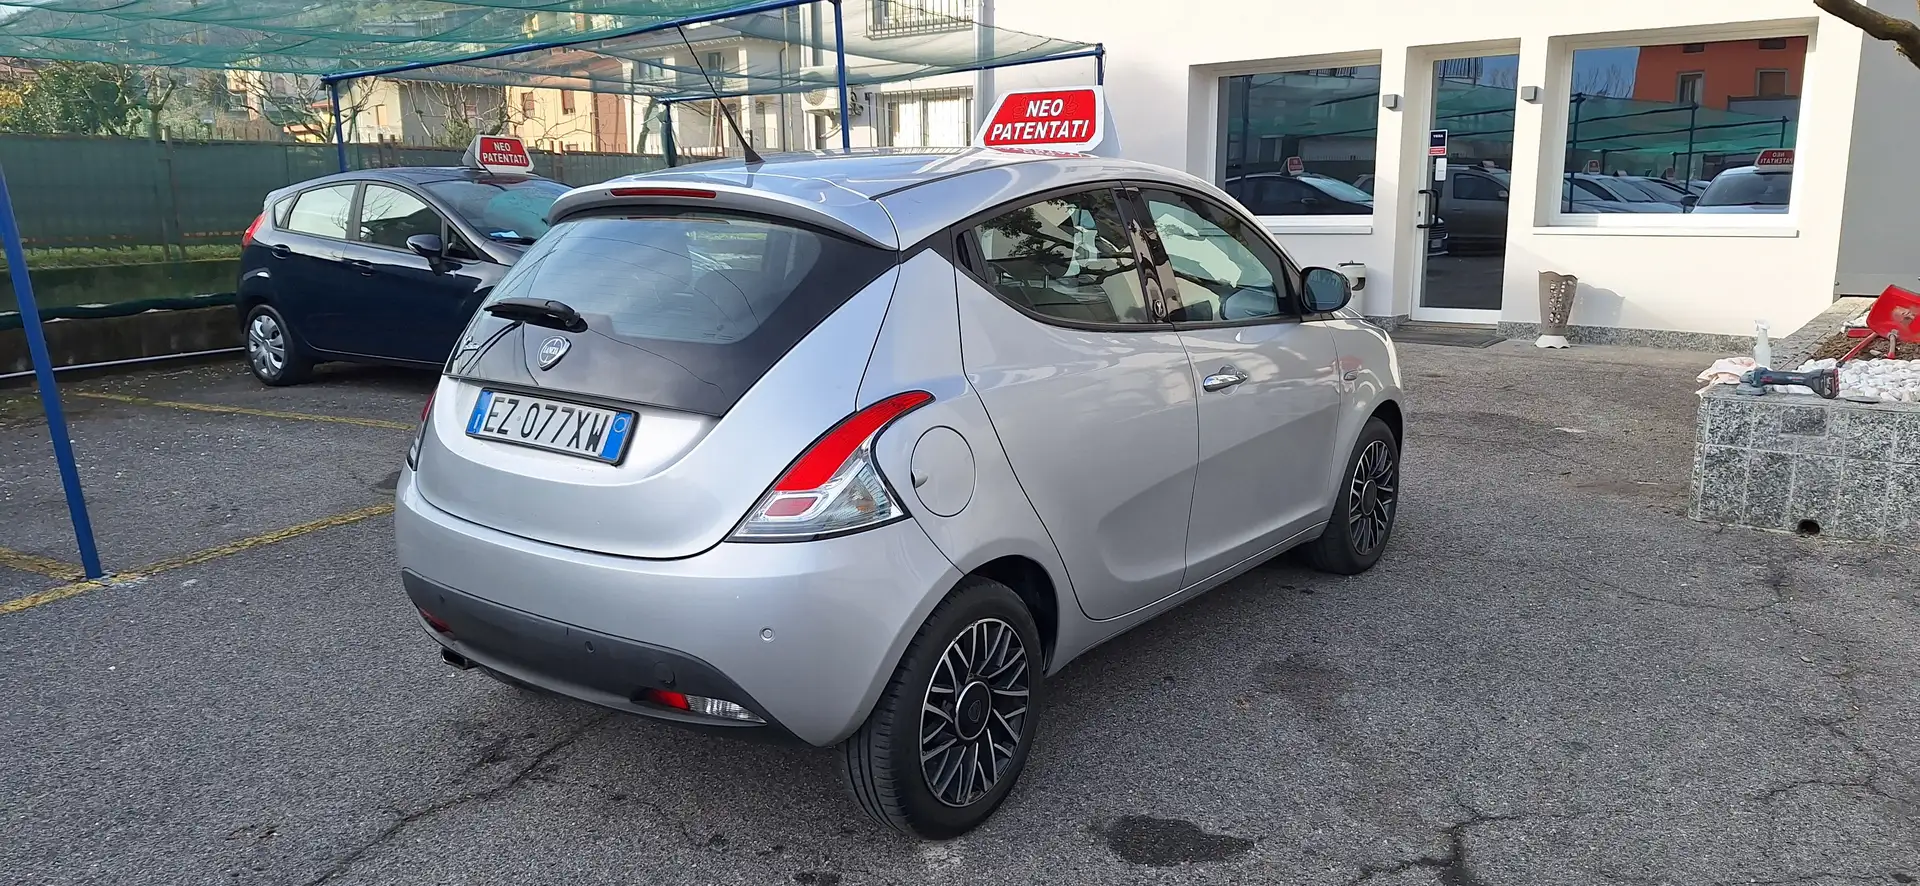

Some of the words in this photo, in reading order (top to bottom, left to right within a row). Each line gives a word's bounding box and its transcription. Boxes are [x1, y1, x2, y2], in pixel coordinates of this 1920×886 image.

[1025, 98, 1064, 118] NEO
[990, 119, 1090, 141] PATENTATI
[493, 141, 511, 152] NEO
[482, 152, 526, 164] PATENTATI
[482, 395, 521, 435] EZ
[519, 401, 611, 453] 077XW
